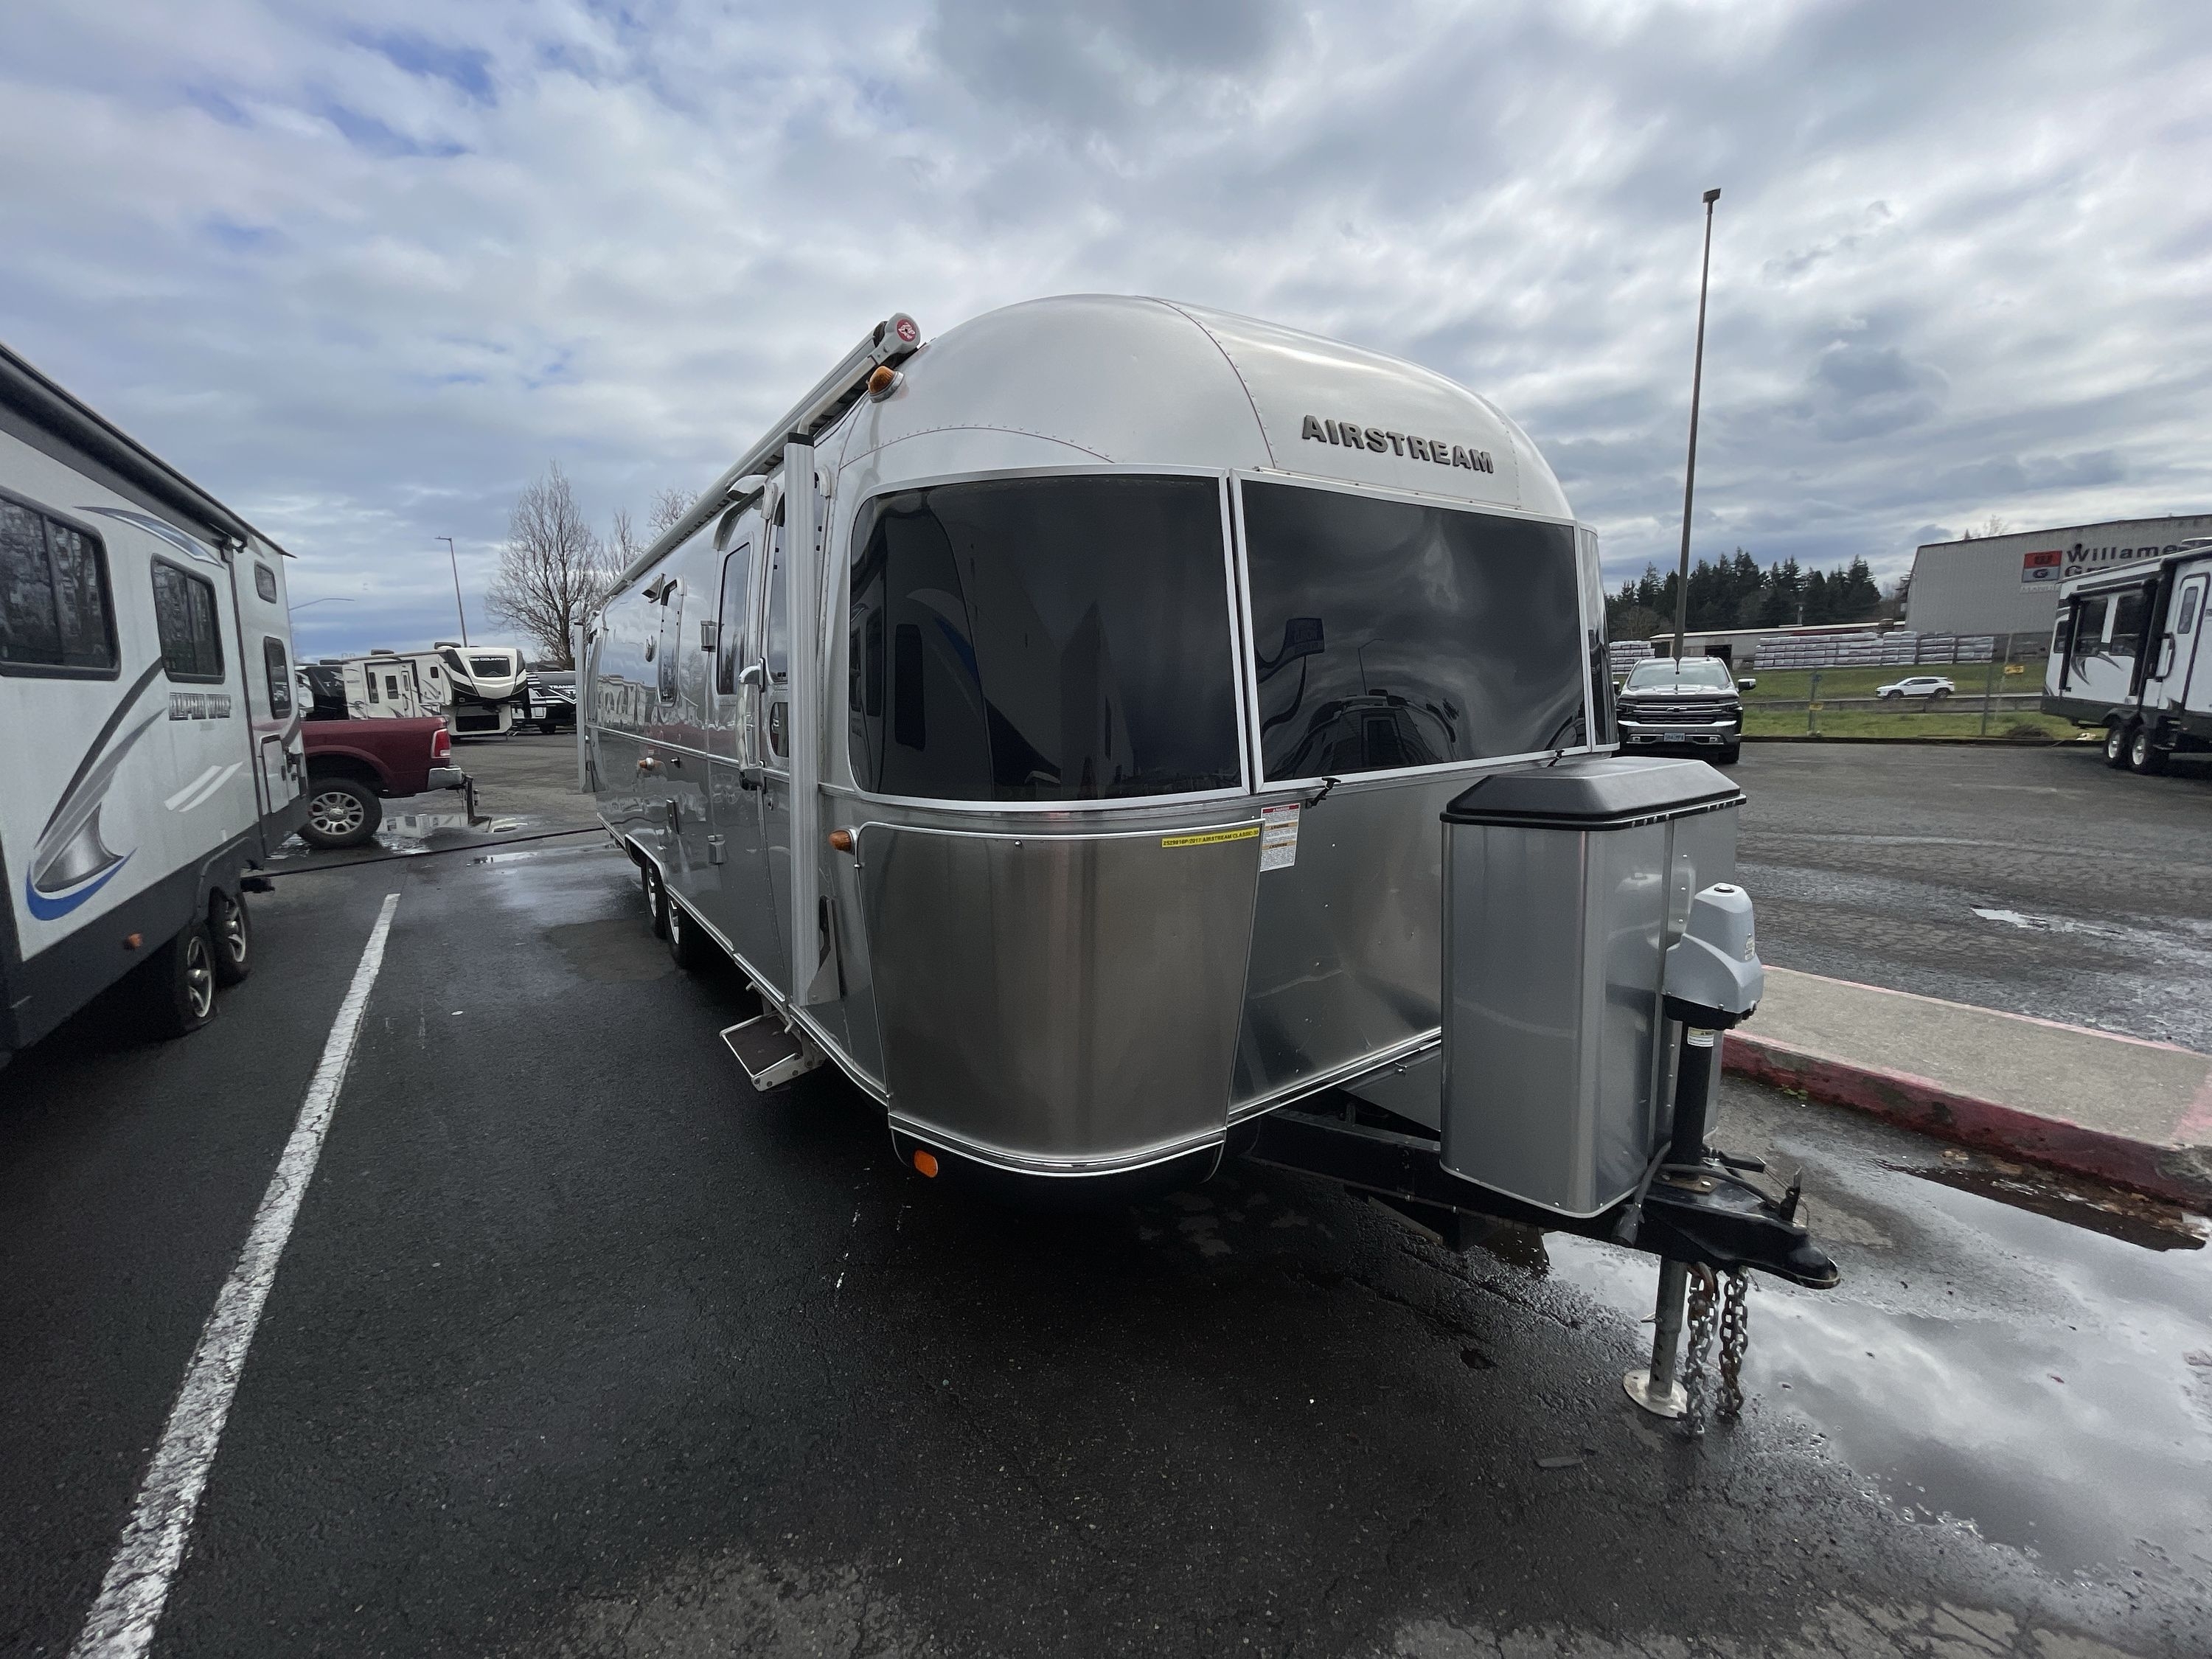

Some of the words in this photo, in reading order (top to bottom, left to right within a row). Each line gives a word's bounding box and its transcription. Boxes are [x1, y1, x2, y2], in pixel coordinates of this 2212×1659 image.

[1301, 414, 1495, 473] AIRSTREAM
[2067, 544, 2178, 563] Willame
[1202, 834, 1232, 843] AIRSTREAM
